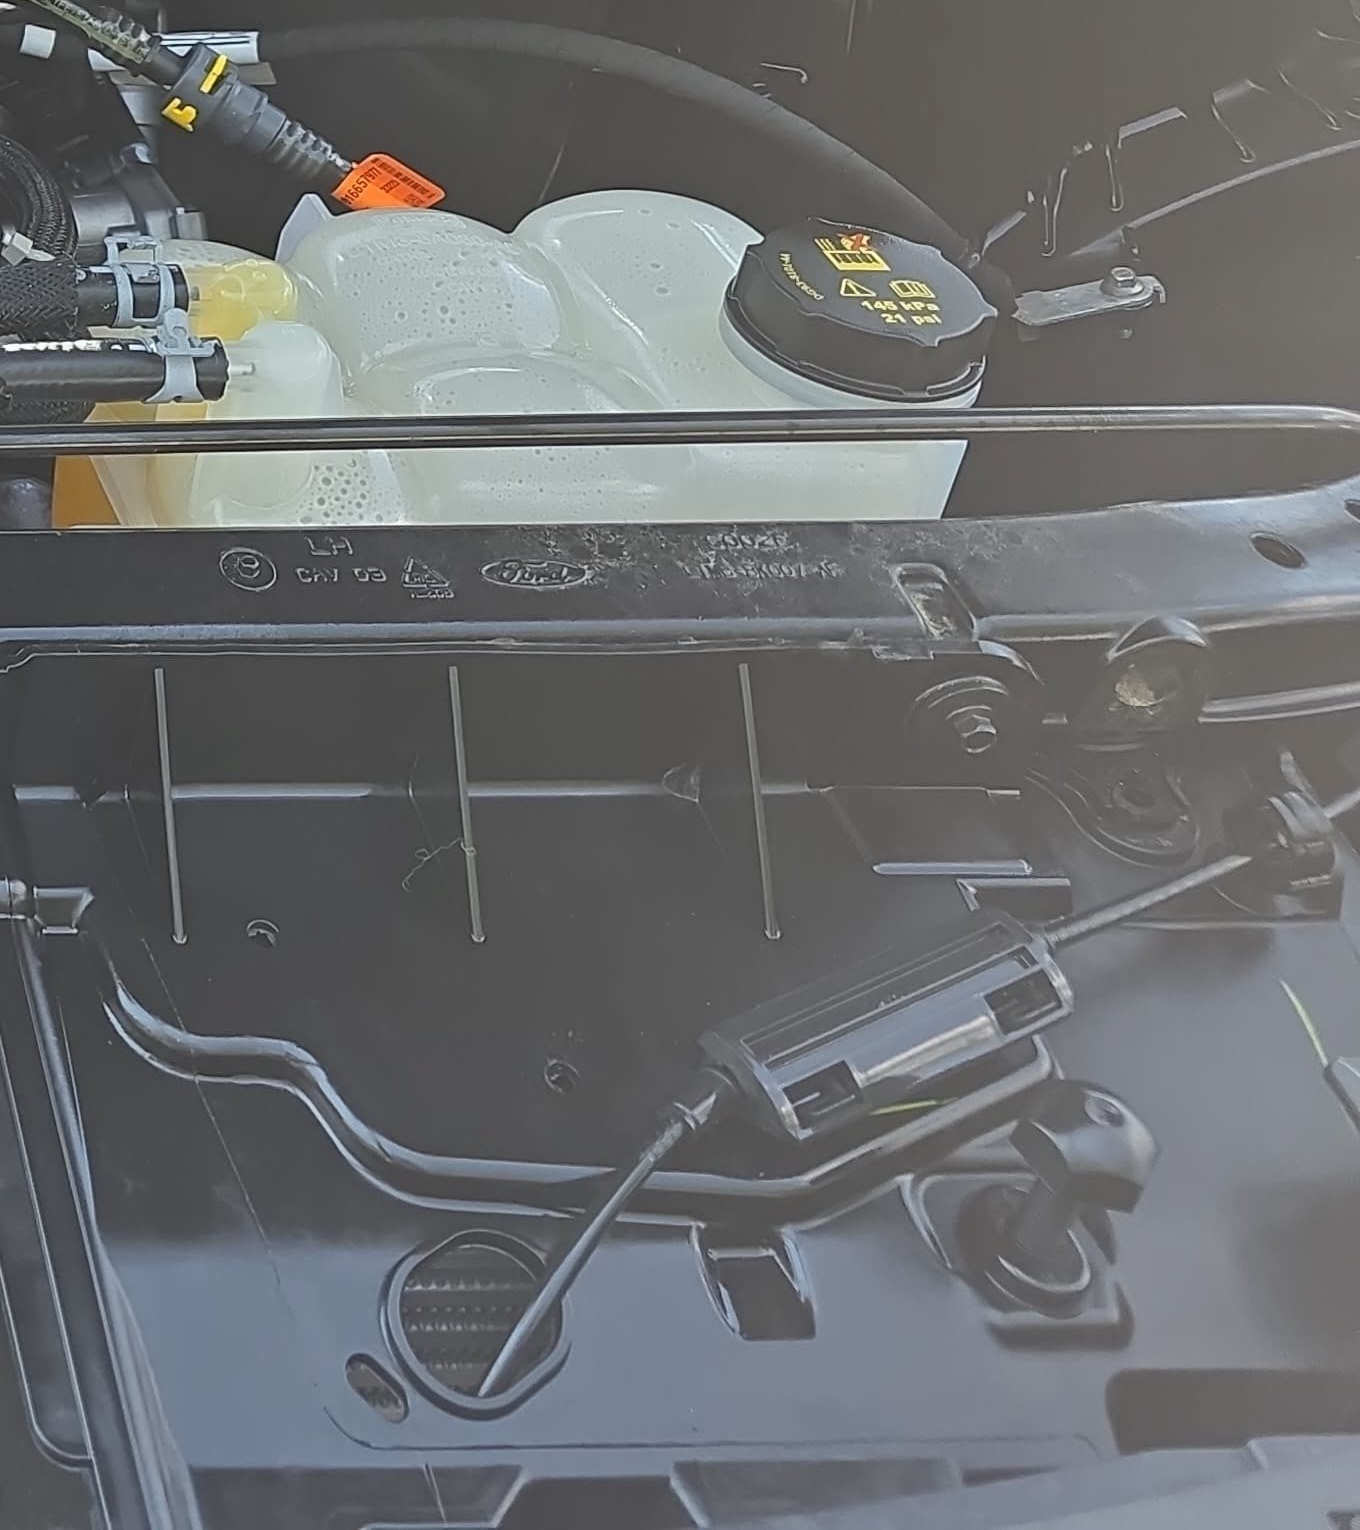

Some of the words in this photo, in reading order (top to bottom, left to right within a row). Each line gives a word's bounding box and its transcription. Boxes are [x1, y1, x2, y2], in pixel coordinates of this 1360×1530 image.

[861, 300, 898, 311] 145
[900, 300, 940, 311] kPa
[881, 313, 907, 324] 21
[304, 536, 354, 556] LH
